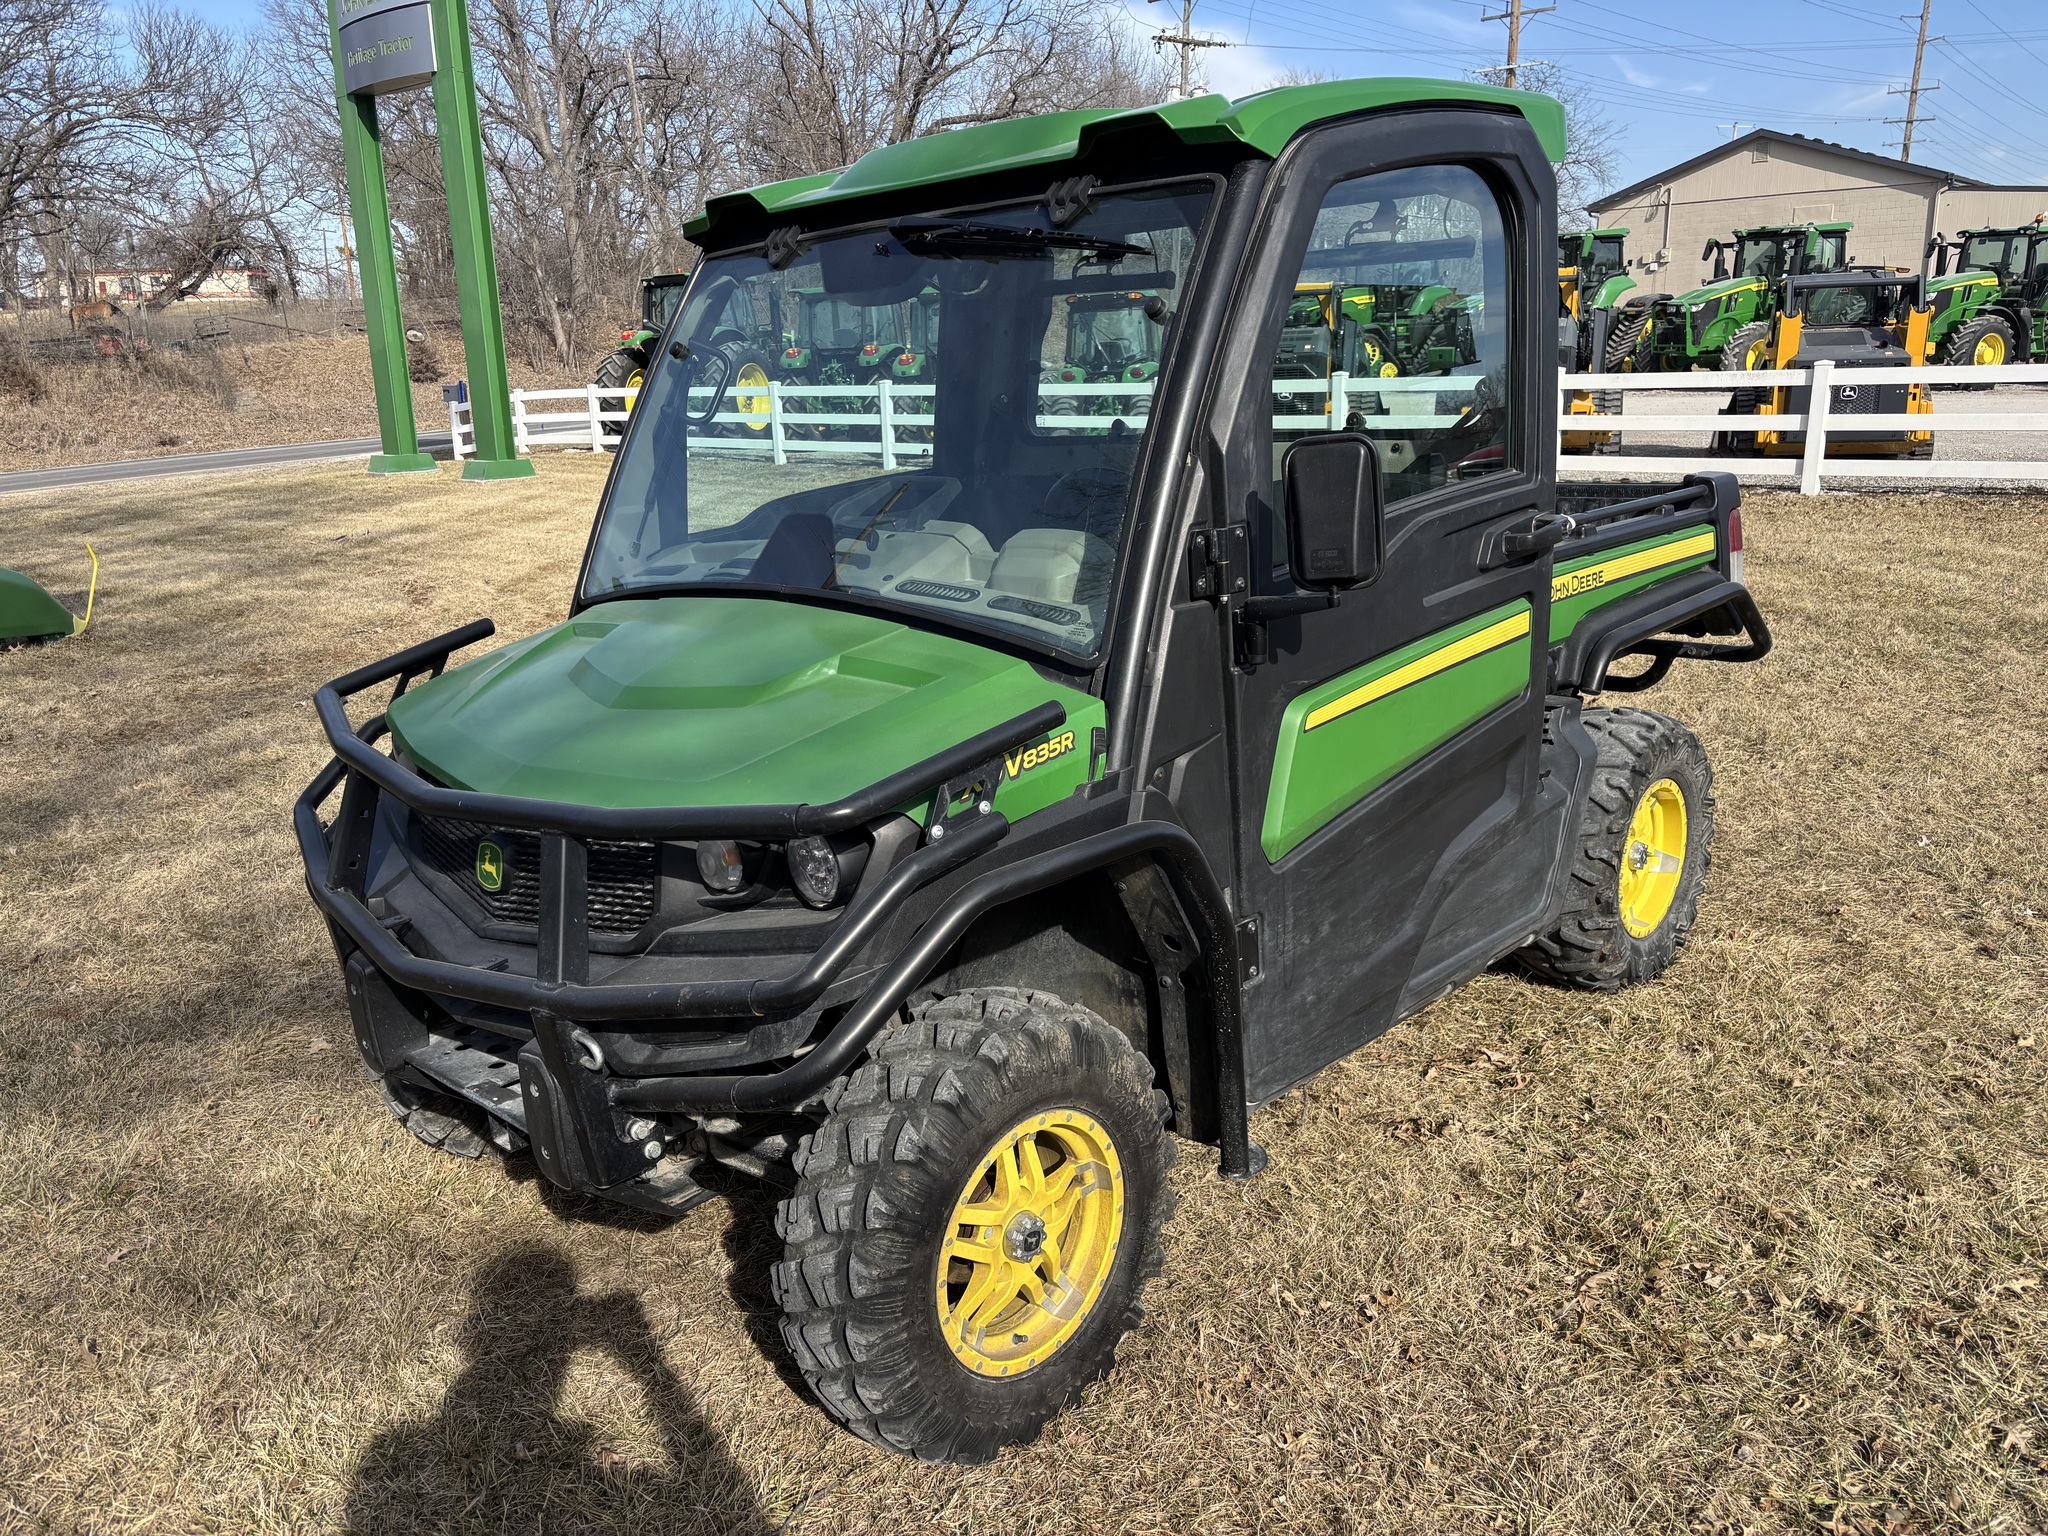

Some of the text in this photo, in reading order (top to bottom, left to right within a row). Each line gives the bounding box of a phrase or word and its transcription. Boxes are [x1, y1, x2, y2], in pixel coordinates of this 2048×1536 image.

[347, 35, 413, 68] Heritage Tractor
[1551, 570, 1604, 599] OHN DEERE
